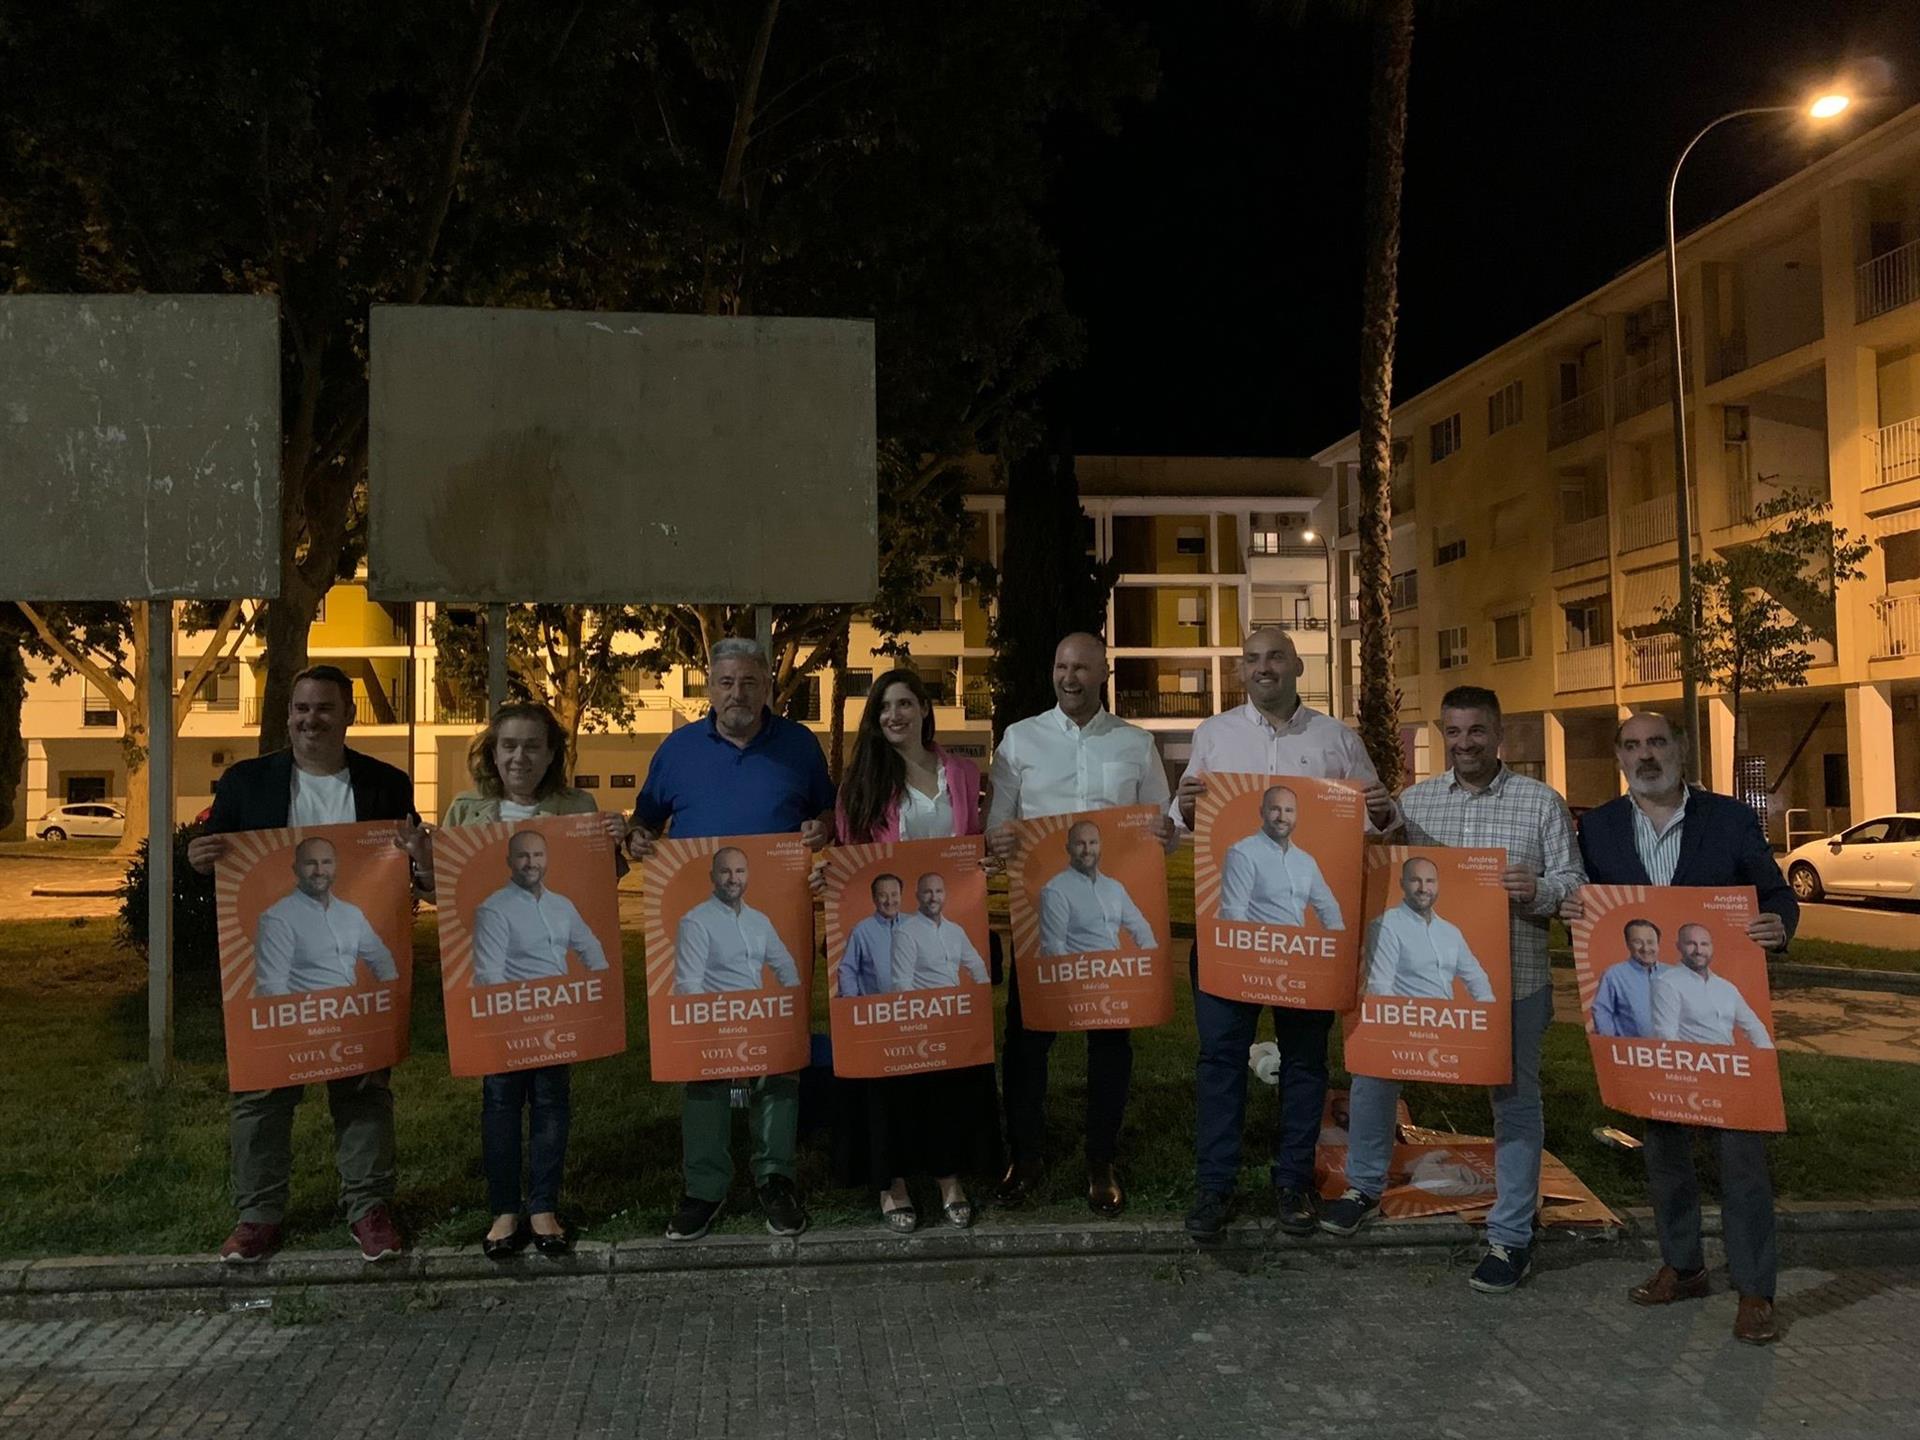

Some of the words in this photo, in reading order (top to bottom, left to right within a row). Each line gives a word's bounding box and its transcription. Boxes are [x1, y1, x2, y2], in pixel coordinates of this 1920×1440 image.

[1467, 855, 1499, 864] Andrés
[1713, 894, 1748, 903] Andrés
[1215, 925, 1337, 958] LIBÉRATE
[1259, 956, 1289, 967] Mérida
[1037, 955, 1153, 984] LIBÉRATE
[1082, 982, 1110, 991] Mérida
[1241, 972, 1274, 988] VOTA
[471, 978, 602, 1018] LIBÉRATE
[1240, 991, 1307, 1005] CIUDADANOS
[251, 989, 391, 1030] LIBÉRATE
[670, 995, 794, 1026] LIBÉRATE
[853, 994, 972, 1026] LIBÉRATE
[1067, 1002, 1098, 1014] VOTA
[1361, 999, 1488, 1031] LIBÉRATE
[522, 1013, 555, 1024] Mérida
[1068, 1017, 1130, 1027] CIUDADANOS
[307, 1026, 342, 1036] Mérida
[718, 1026, 748, 1035] Mérida
[900, 1023, 928, 1033] Mérida
[1408, 1030, 1440, 1040] Mérida
[506, 1036, 541, 1051] VOTA
[288, 1050, 326, 1064] VOTA
[701, 1048, 734, 1060] VOTA
[883, 1044, 914, 1058] VOTA
[1391, 1049, 1425, 1063] VOTA
[506, 1050, 578, 1068] CIUDADANOS
[883, 1059, 948, 1073] CIUDADANOS
[1612, 1042, 1752, 1078] LIBÉRATE
[288, 1063, 365, 1081] CIUDADANOS
[701, 1063, 769, 1076] CIUDADANOS
[1391, 1067, 1460, 1080] CIUDADANOS
[1665, 1072, 1699, 1084] Mérida
[1649, 1091, 1685, 1106] VOTA
[1651, 1108, 1725, 1125] CIUDADANOS
